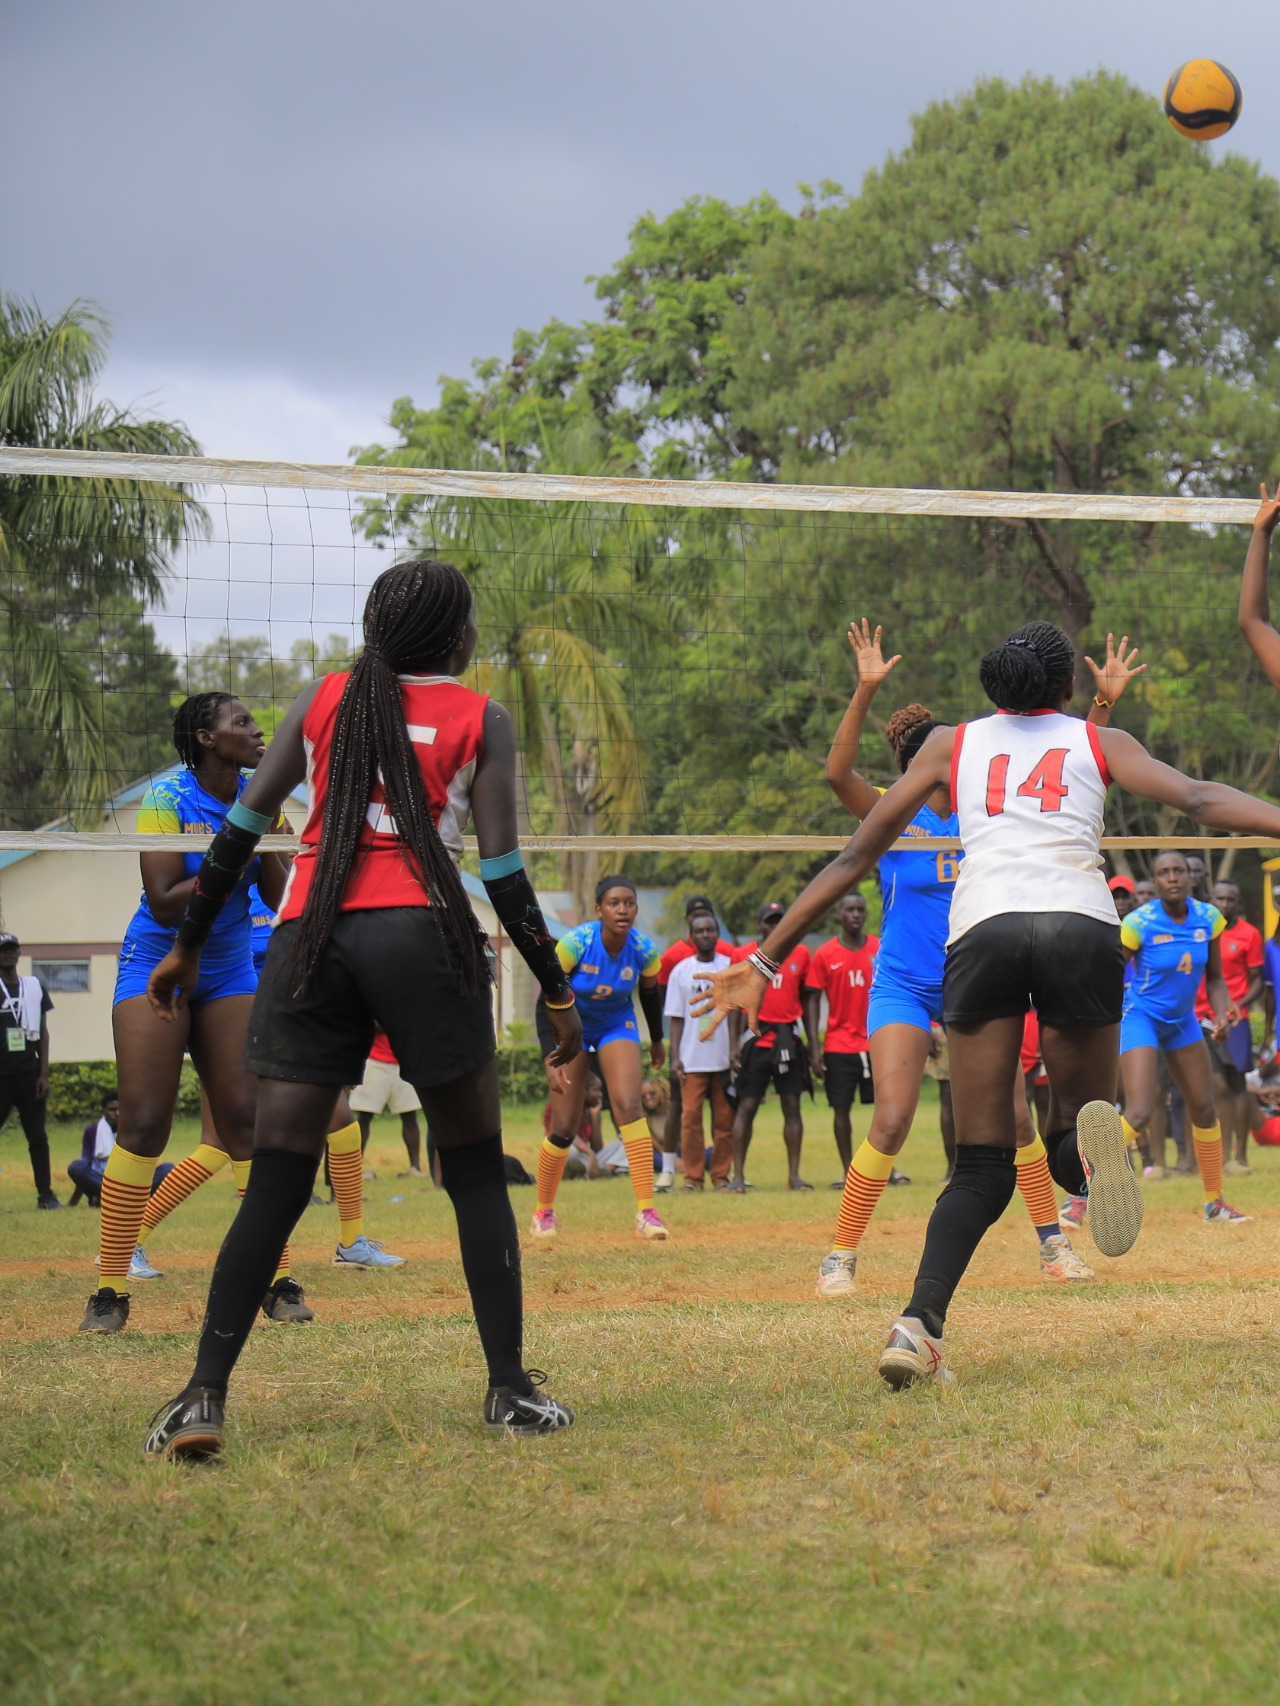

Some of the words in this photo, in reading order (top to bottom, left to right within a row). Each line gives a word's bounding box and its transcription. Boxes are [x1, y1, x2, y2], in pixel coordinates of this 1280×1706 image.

[985, 748, 1071, 817] 14
[184, 822, 213, 834] MUBS
[936, 850, 959, 883] 6
[1176, 951, 1193, 975] 4
[848, 969, 866, 987] 14
[591, 984, 612, 1000] 2
